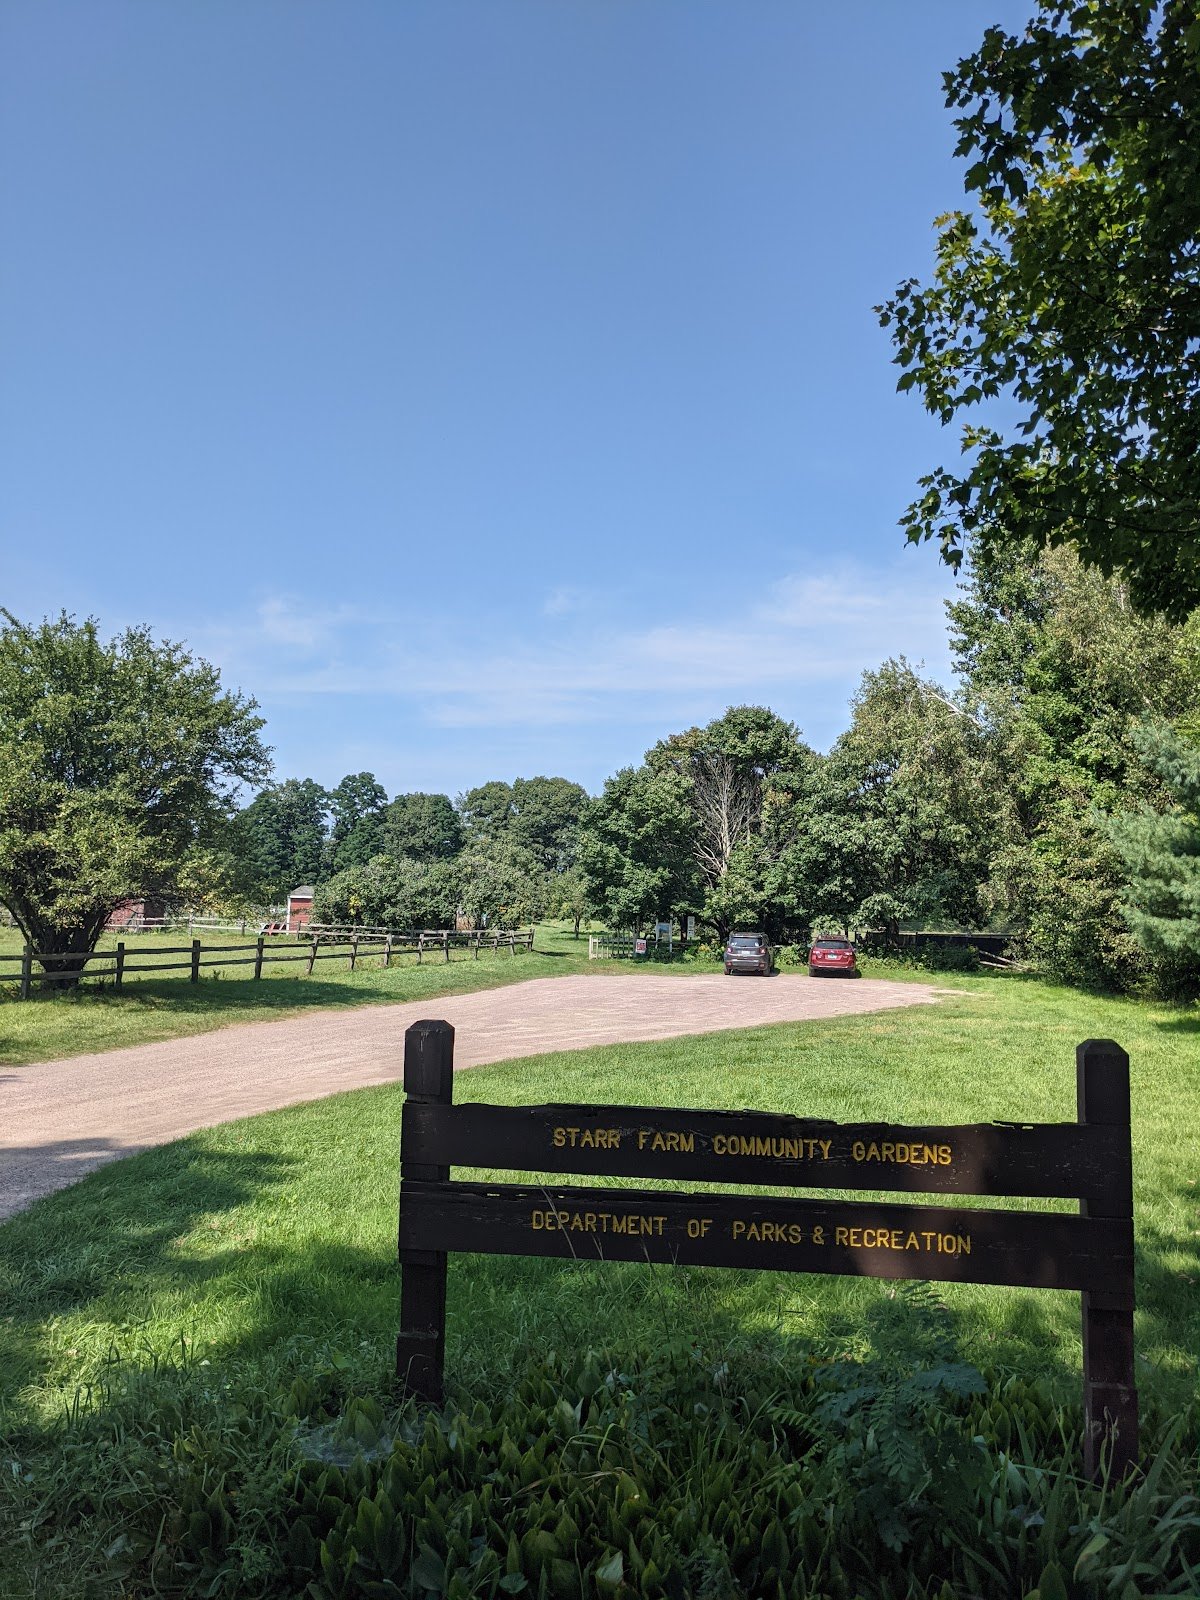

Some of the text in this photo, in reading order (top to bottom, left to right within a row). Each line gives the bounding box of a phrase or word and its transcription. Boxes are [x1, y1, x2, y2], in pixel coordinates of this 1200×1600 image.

[552, 1126, 953, 1166] STARR FARM COMMUNITY GARDENS
[531, 1210, 972, 1255] DEPARTMENT OF PARKS & RECREATION
